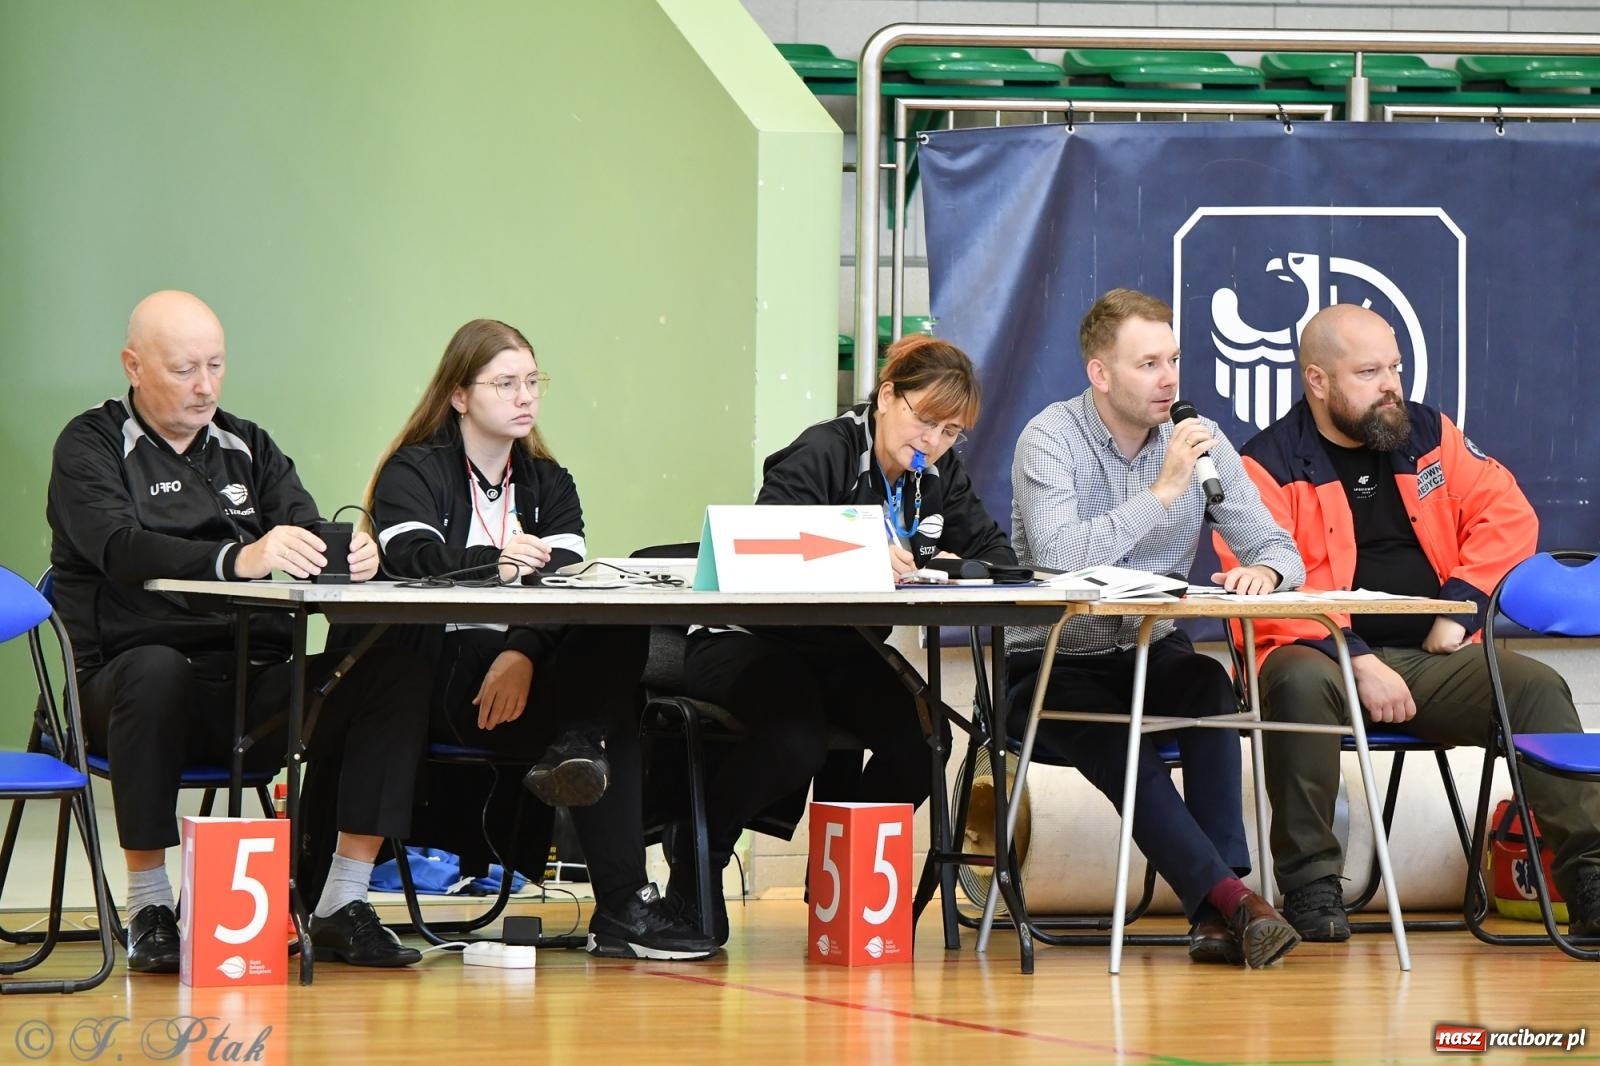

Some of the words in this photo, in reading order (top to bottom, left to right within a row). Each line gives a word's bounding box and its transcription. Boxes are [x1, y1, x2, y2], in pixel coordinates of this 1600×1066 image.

[213, 837, 276, 945] 5
[815, 822, 844, 923] 5
[862, 822, 903, 925] 5
